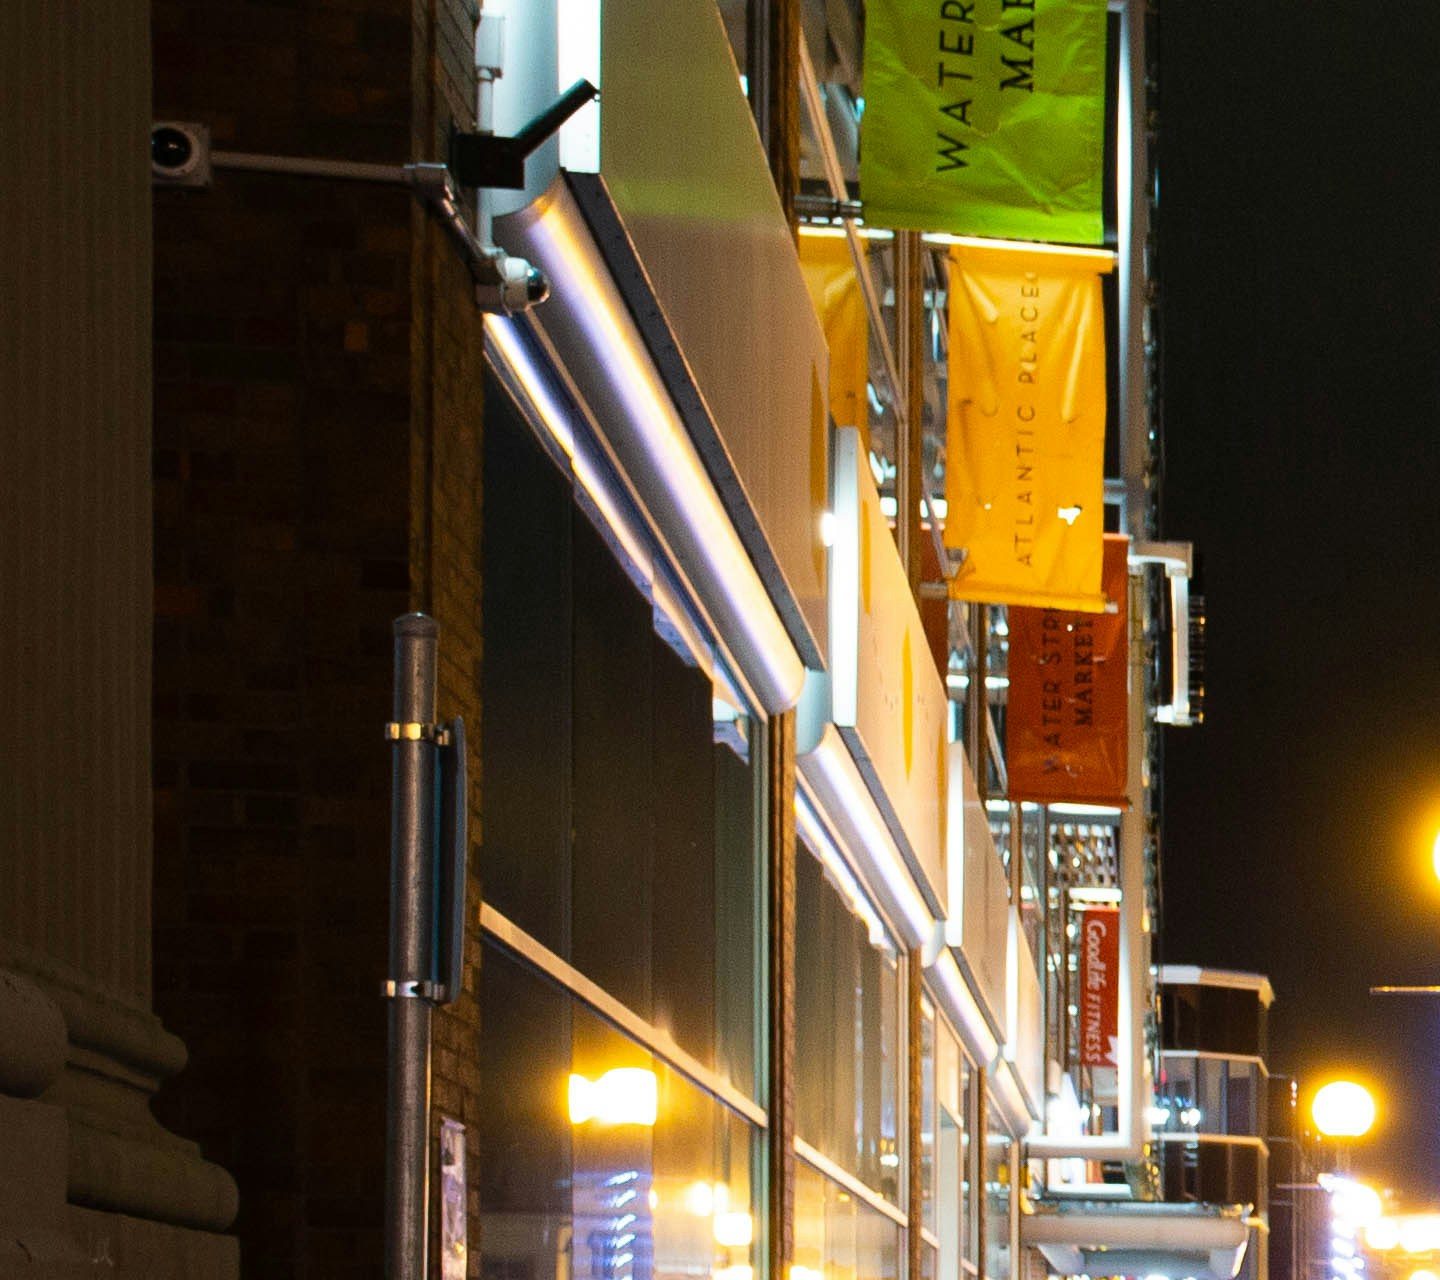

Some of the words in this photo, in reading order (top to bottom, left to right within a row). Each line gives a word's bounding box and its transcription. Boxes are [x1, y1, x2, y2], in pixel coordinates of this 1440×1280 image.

[1018, 281, 1039, 385] PLACE
[1014, 404, 1036, 568] ATLANTIC
[1041, 607, 1063, 666] STR
[1073, 616, 1094, 727] MARKET
[1085, 992, 1101, 1063] FITNESS
